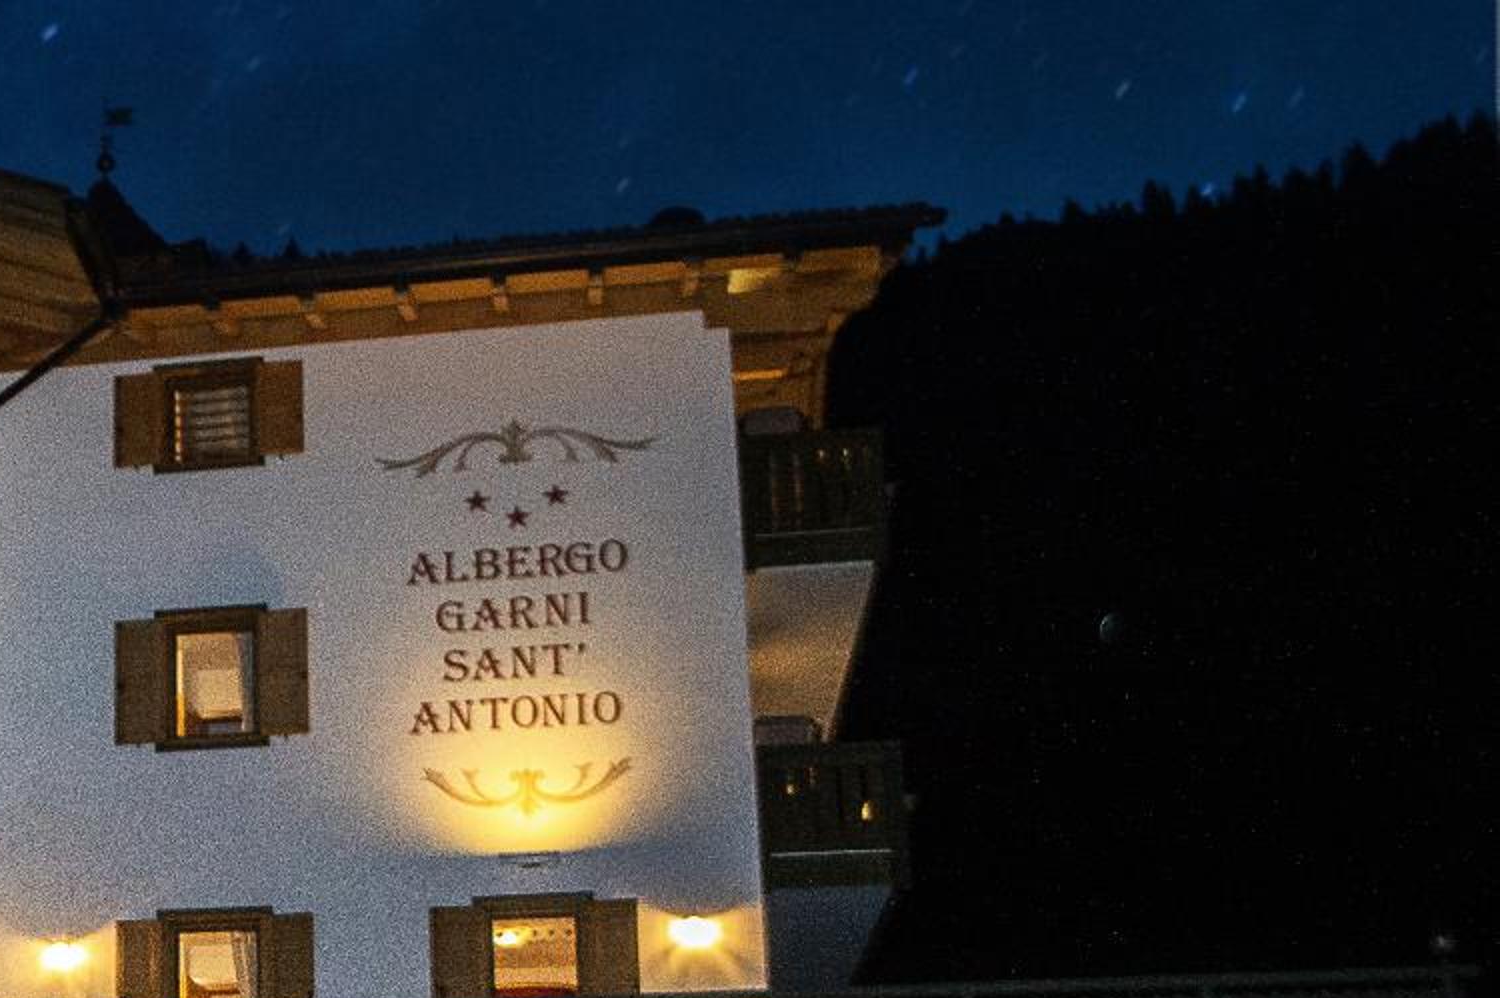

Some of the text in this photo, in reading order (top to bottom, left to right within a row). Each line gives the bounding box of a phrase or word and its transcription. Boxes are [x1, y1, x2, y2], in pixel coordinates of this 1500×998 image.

[407, 538, 629, 585] ALBERGO
[435, 591, 591, 632] GARNI
[443, 642, 586, 682] SANT'
[410, 691, 623, 735] ANTONIO
